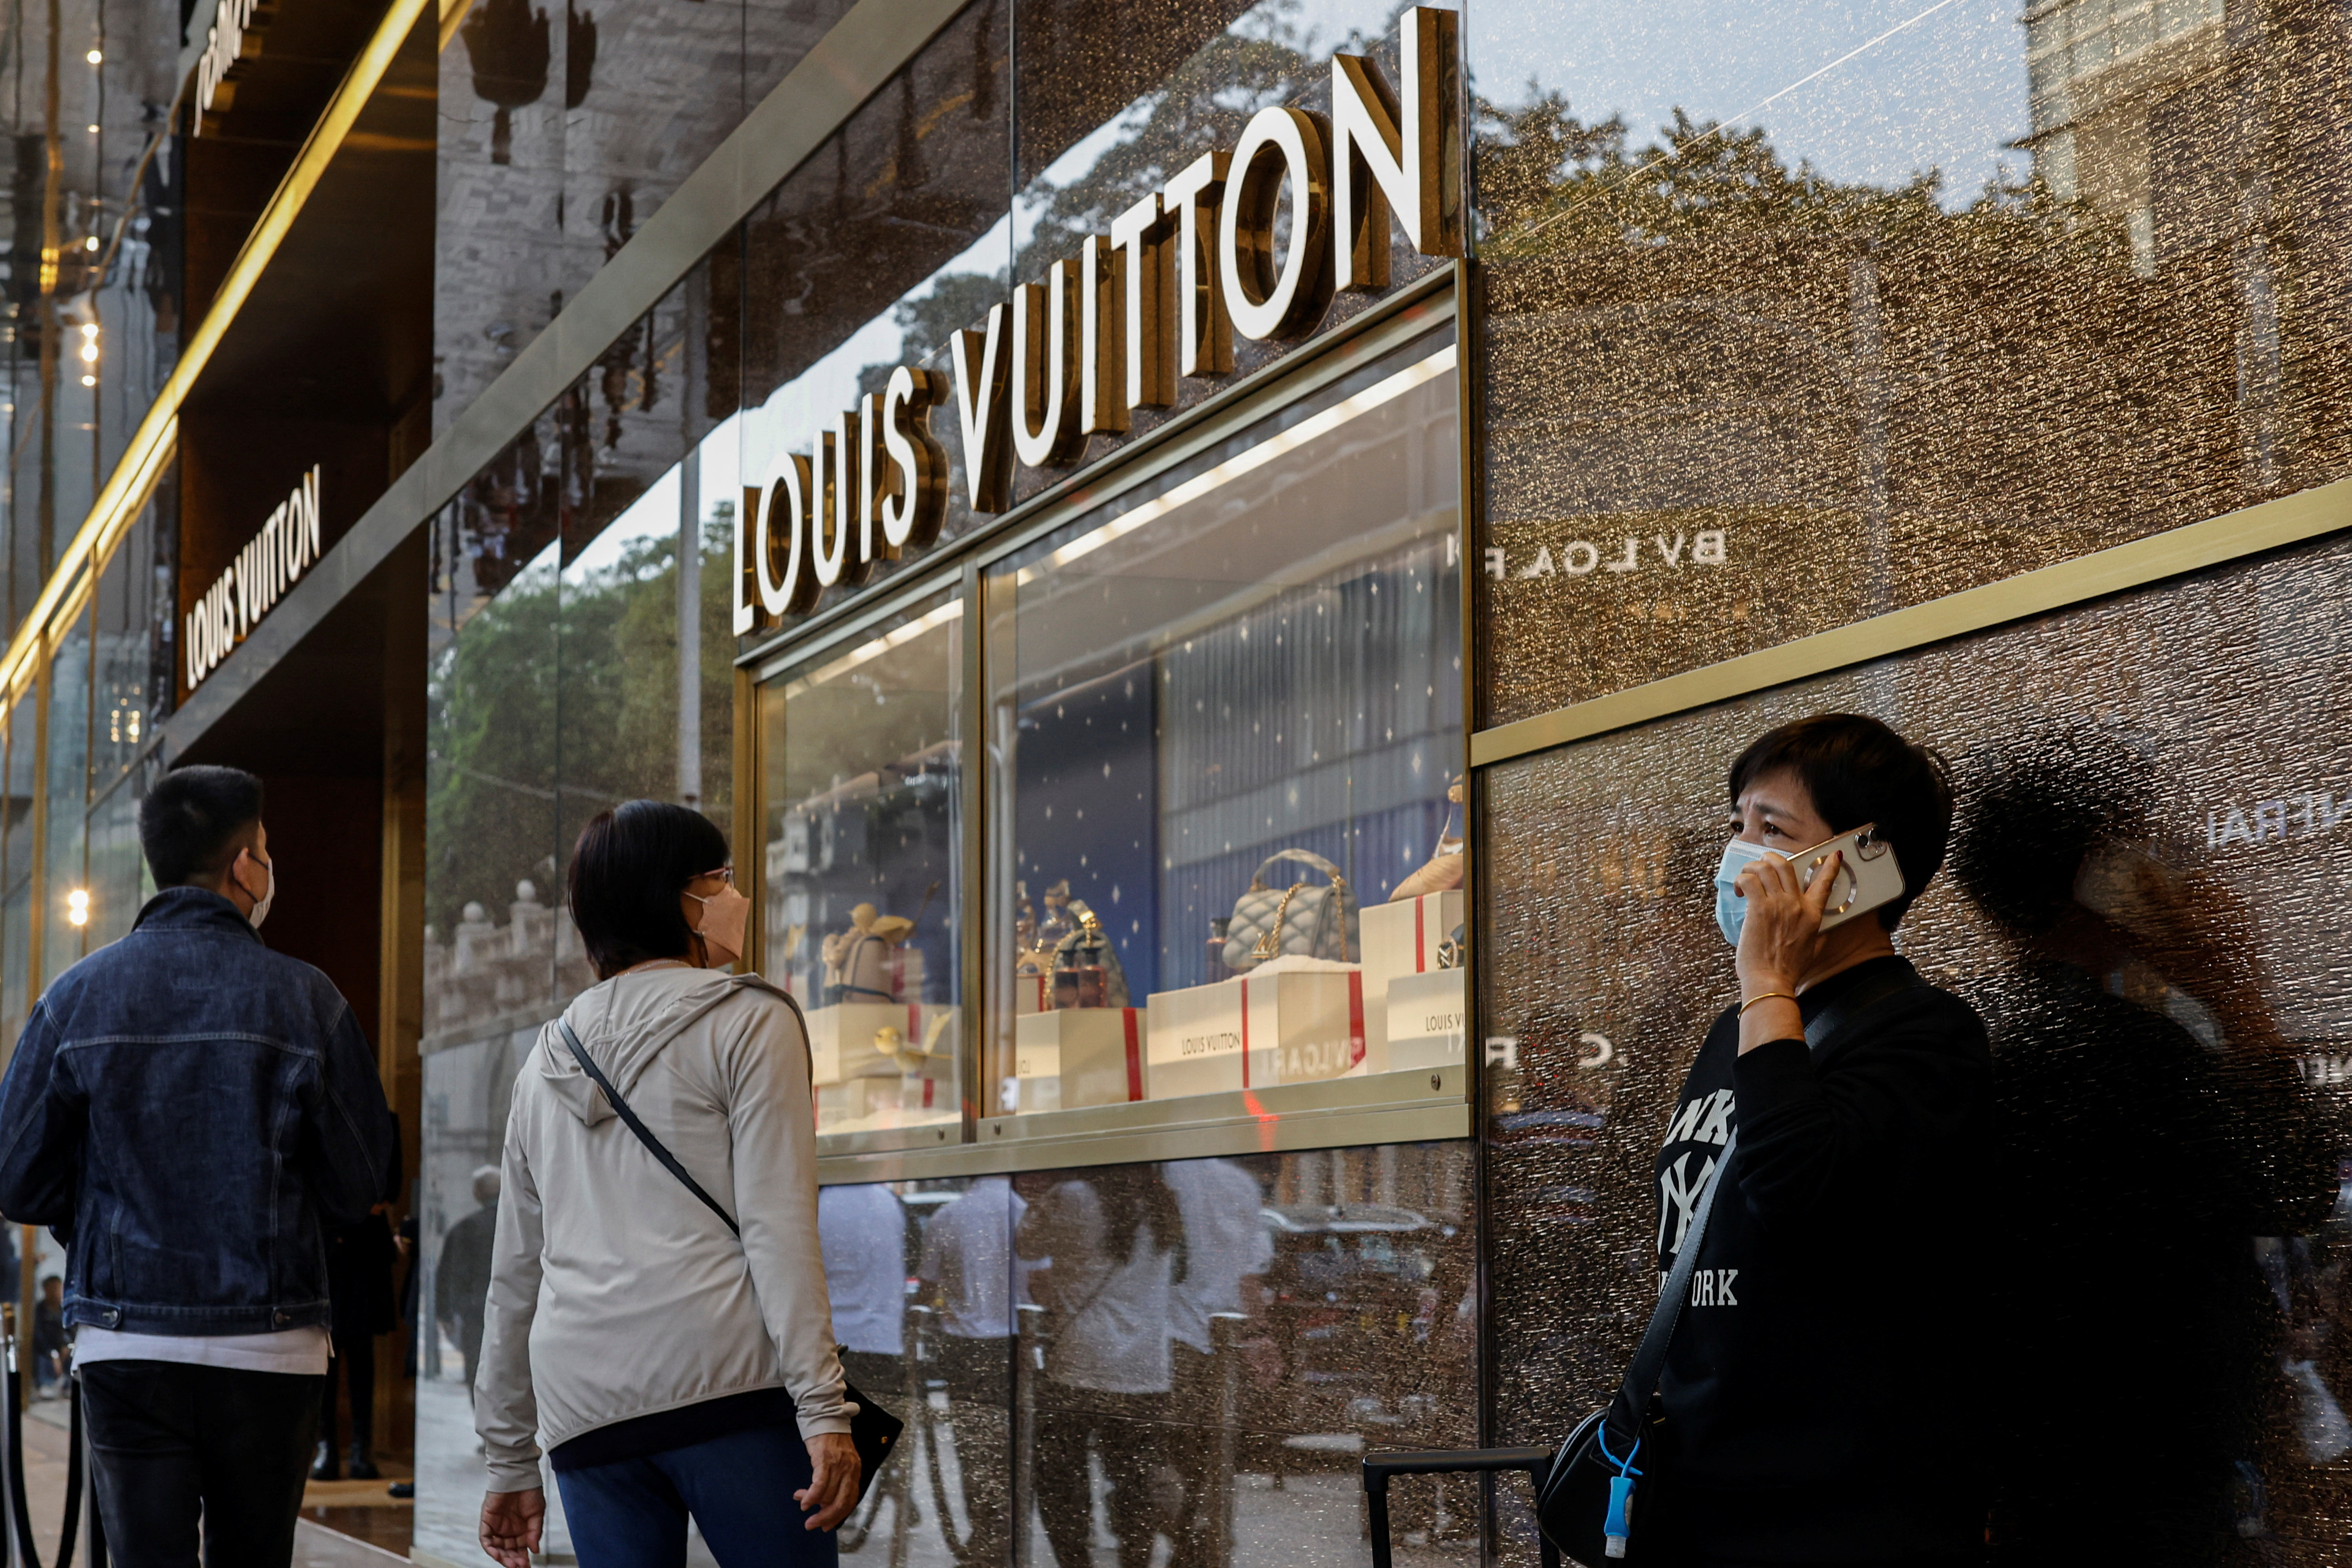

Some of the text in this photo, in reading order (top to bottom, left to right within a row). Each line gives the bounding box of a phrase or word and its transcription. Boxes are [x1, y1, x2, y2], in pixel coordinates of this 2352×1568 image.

[733, 8, 1422, 636] LOUIS VUITTON
[186, 463, 320, 690] LOUIS VUITTON
[1182, 1032, 1240, 1055] LOUIS VUITTON
[1426, 1014, 1452, 1031] LOUIS
